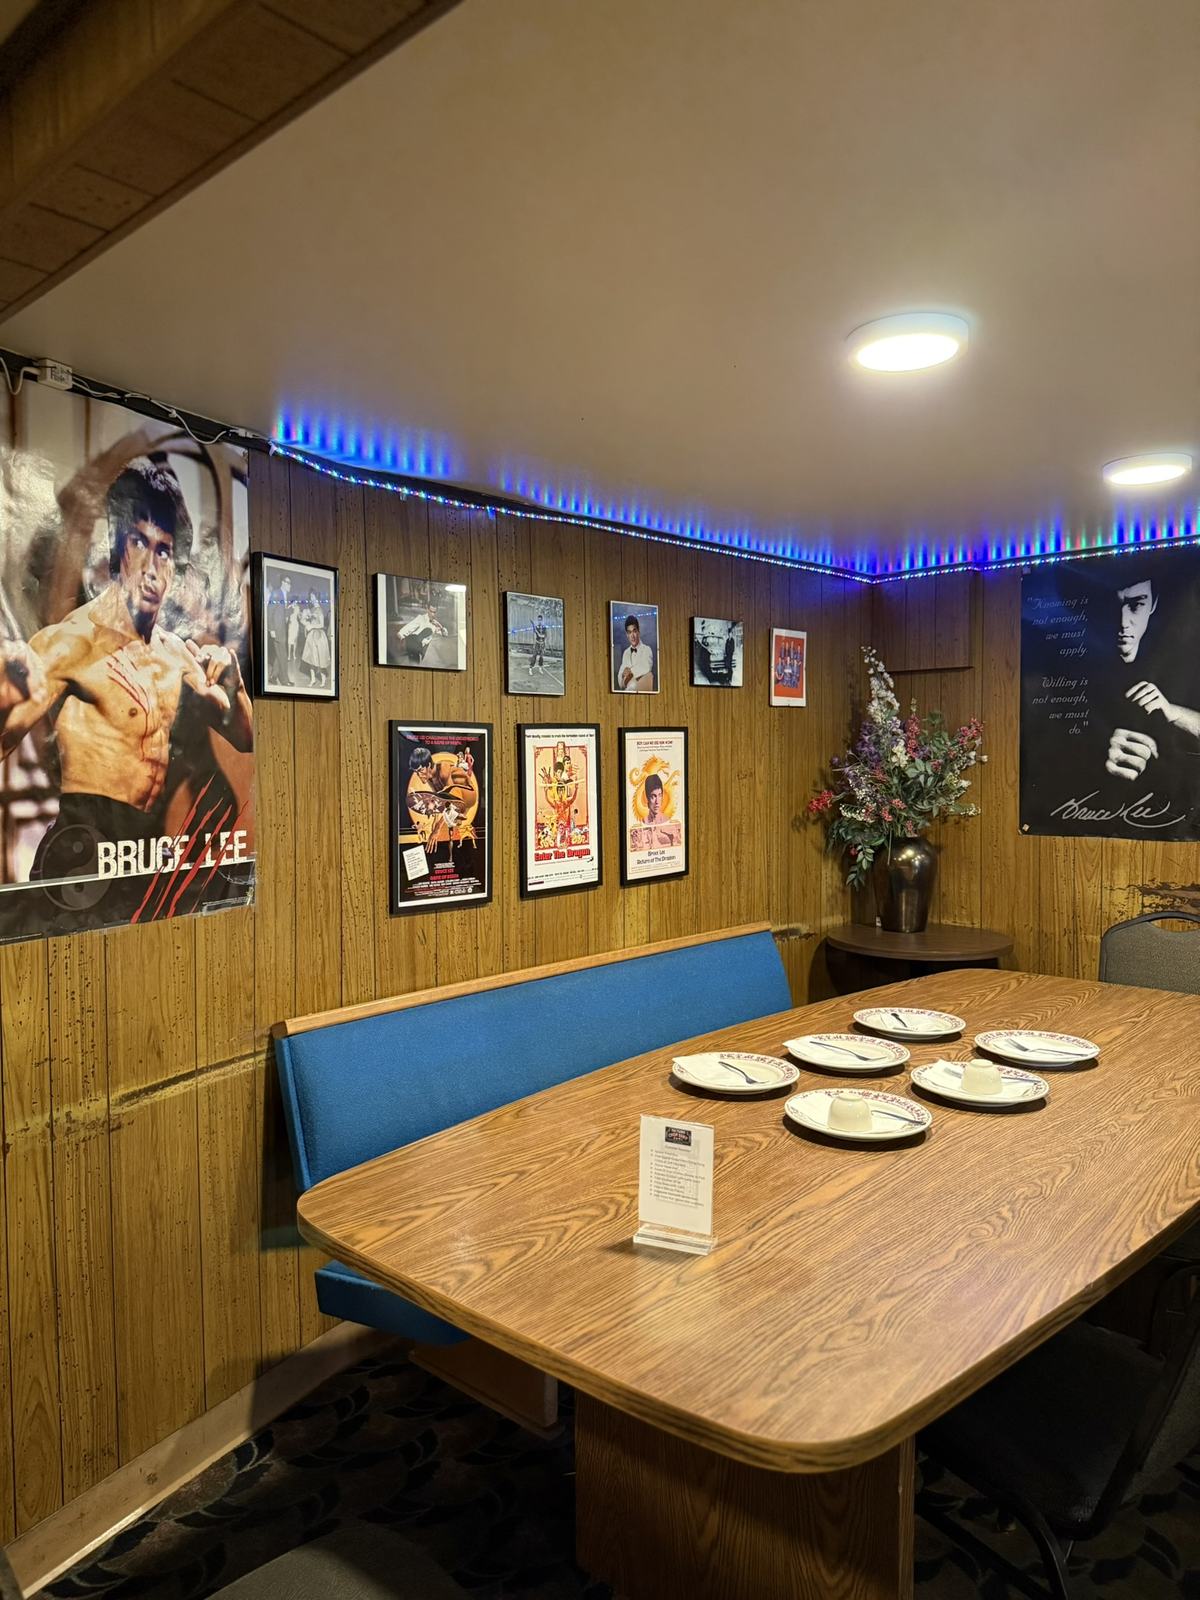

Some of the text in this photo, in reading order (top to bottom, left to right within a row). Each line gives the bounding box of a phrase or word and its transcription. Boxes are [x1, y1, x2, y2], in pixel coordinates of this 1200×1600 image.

[1080, 596, 1089, 605] is
[1032, 609, 1089, 626] not enough,
[1061, 627, 1087, 639] must
[1059, 641, 1089, 658] apply.
[1041, 675, 1089, 690] Willing is
[1032, 689, 1089, 706] not enough,
[1064, 708, 1090, 719] must
[97, 829, 248, 880] BRUCE LEE
[534, 852, 553, 862] Enter
[553, 849, 566, 860] The
[567, 848, 591, 859] Dragon
